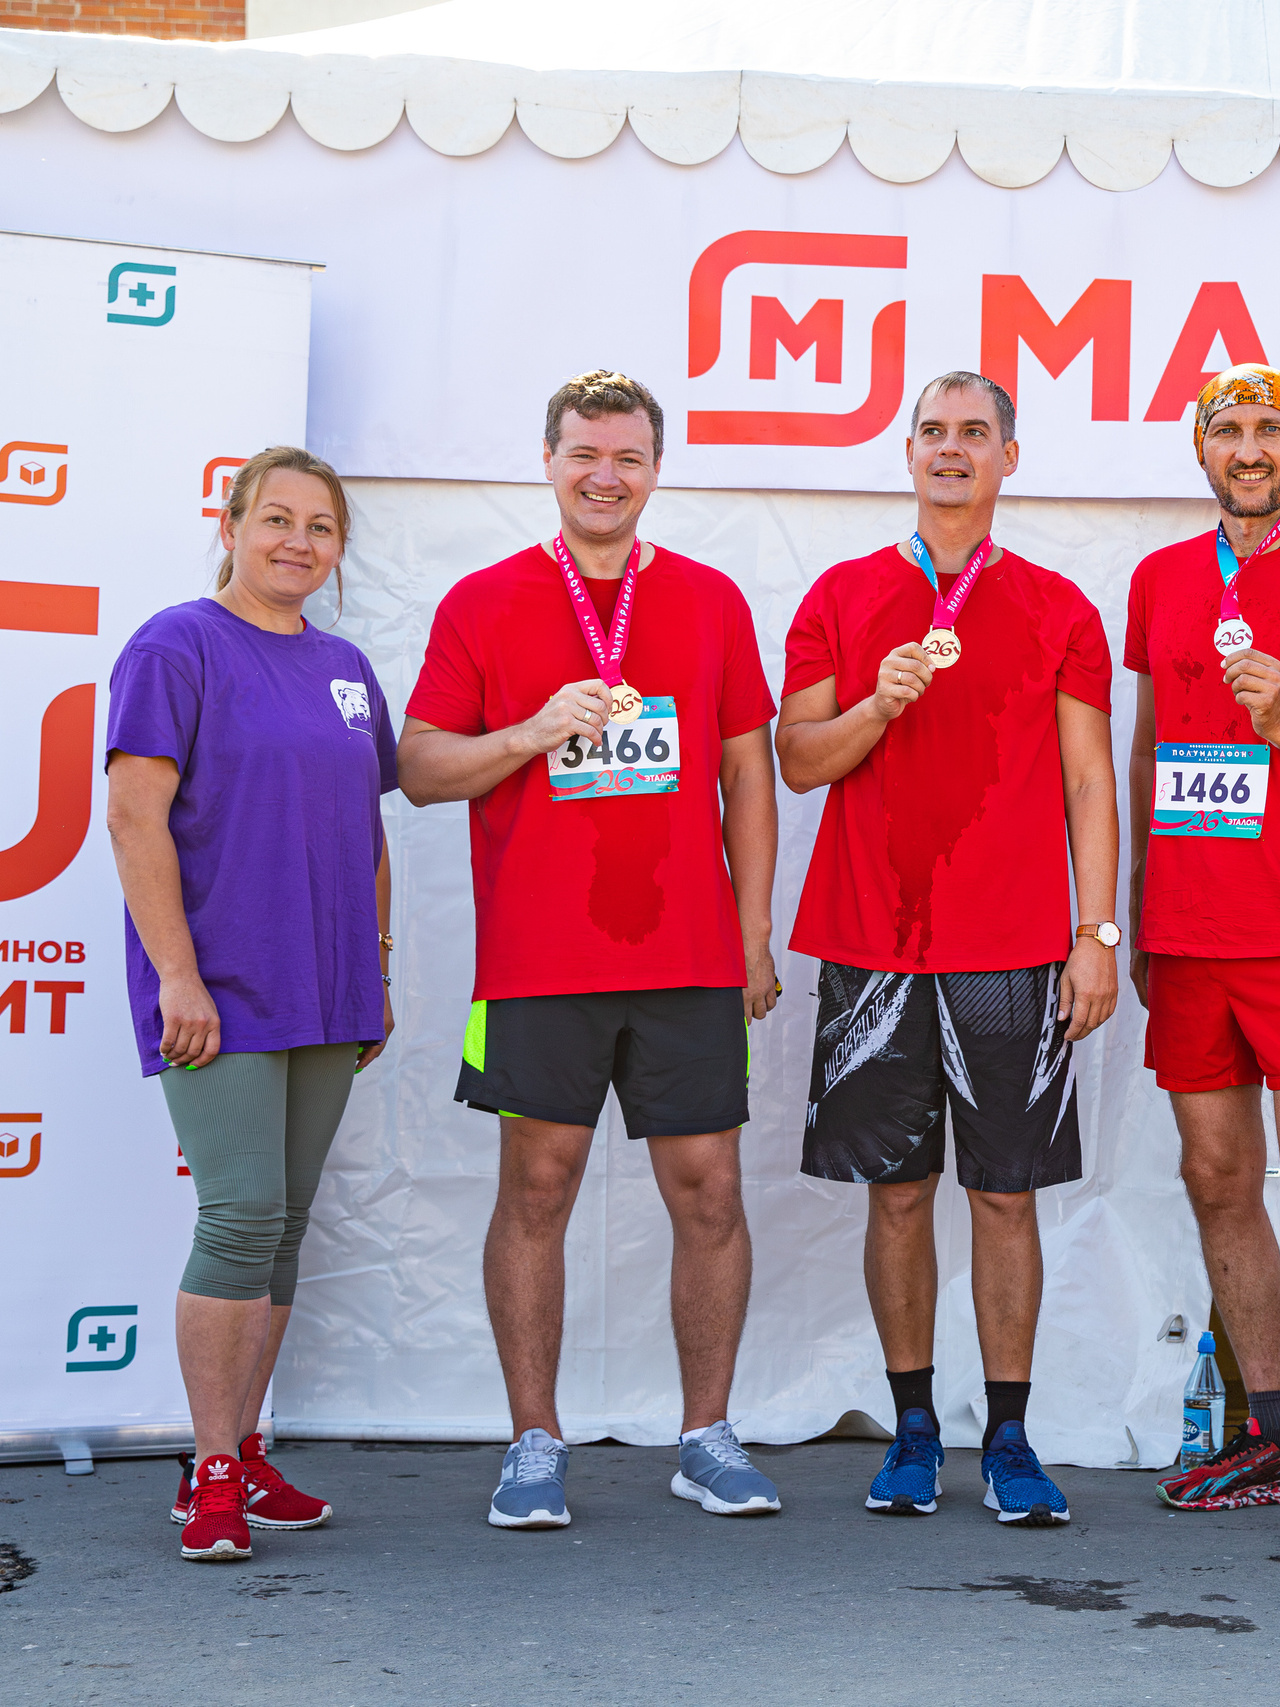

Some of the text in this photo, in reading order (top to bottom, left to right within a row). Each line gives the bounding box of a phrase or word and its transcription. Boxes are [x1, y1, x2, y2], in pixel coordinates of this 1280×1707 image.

[1219, 628, 1246, 648] 26
[926, 640, 955, 657] 26
[561, 727, 670, 768] 3466
[1172, 749, 1247, 758] ПОЛУМАРАФОН
[595, 767, 636, 795] 26
[644, 774, 677, 783] ЭТАЛОН
[1171, 771, 1250, 804] 1466
[1187, 809, 1223, 832] 26
[1228, 818, 1258, 826] ЭТАЛОН
